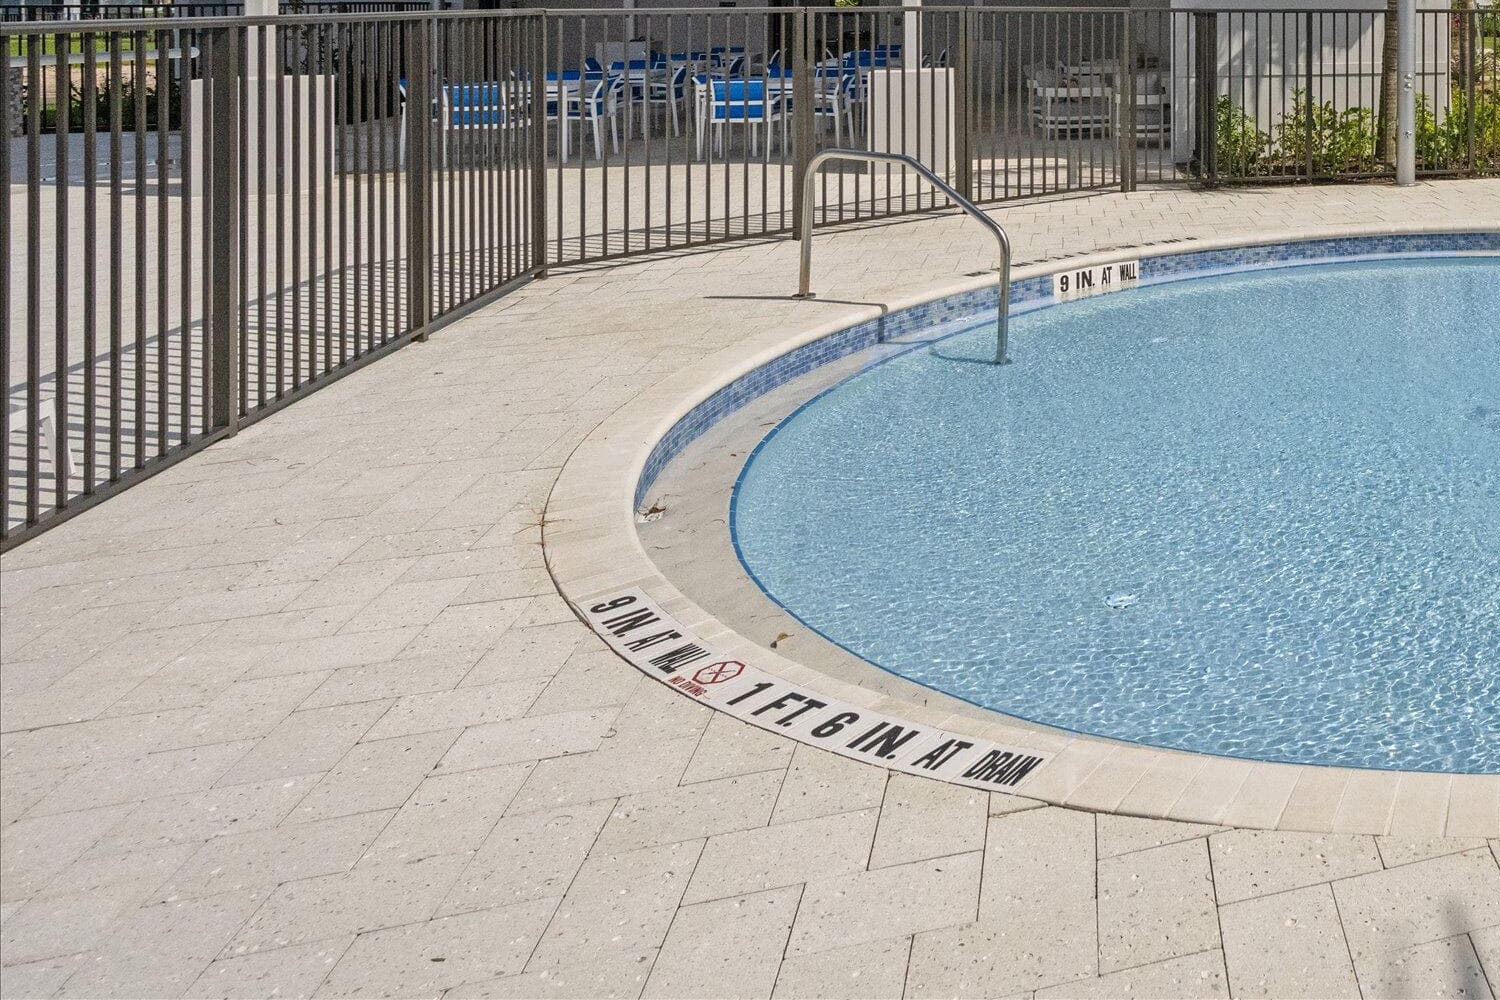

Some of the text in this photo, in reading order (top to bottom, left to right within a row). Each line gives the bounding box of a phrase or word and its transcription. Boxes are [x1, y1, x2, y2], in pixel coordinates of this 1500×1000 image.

[1059, 263, 1137, 293] 9 IN. AT WALL
[589, 594, 713, 675] 9 IN. AT WALL
[668, 675, 709, 698] NO DIVING
[725, 681, 1045, 788] 1 FT. 6 IN. AT DRAIN
